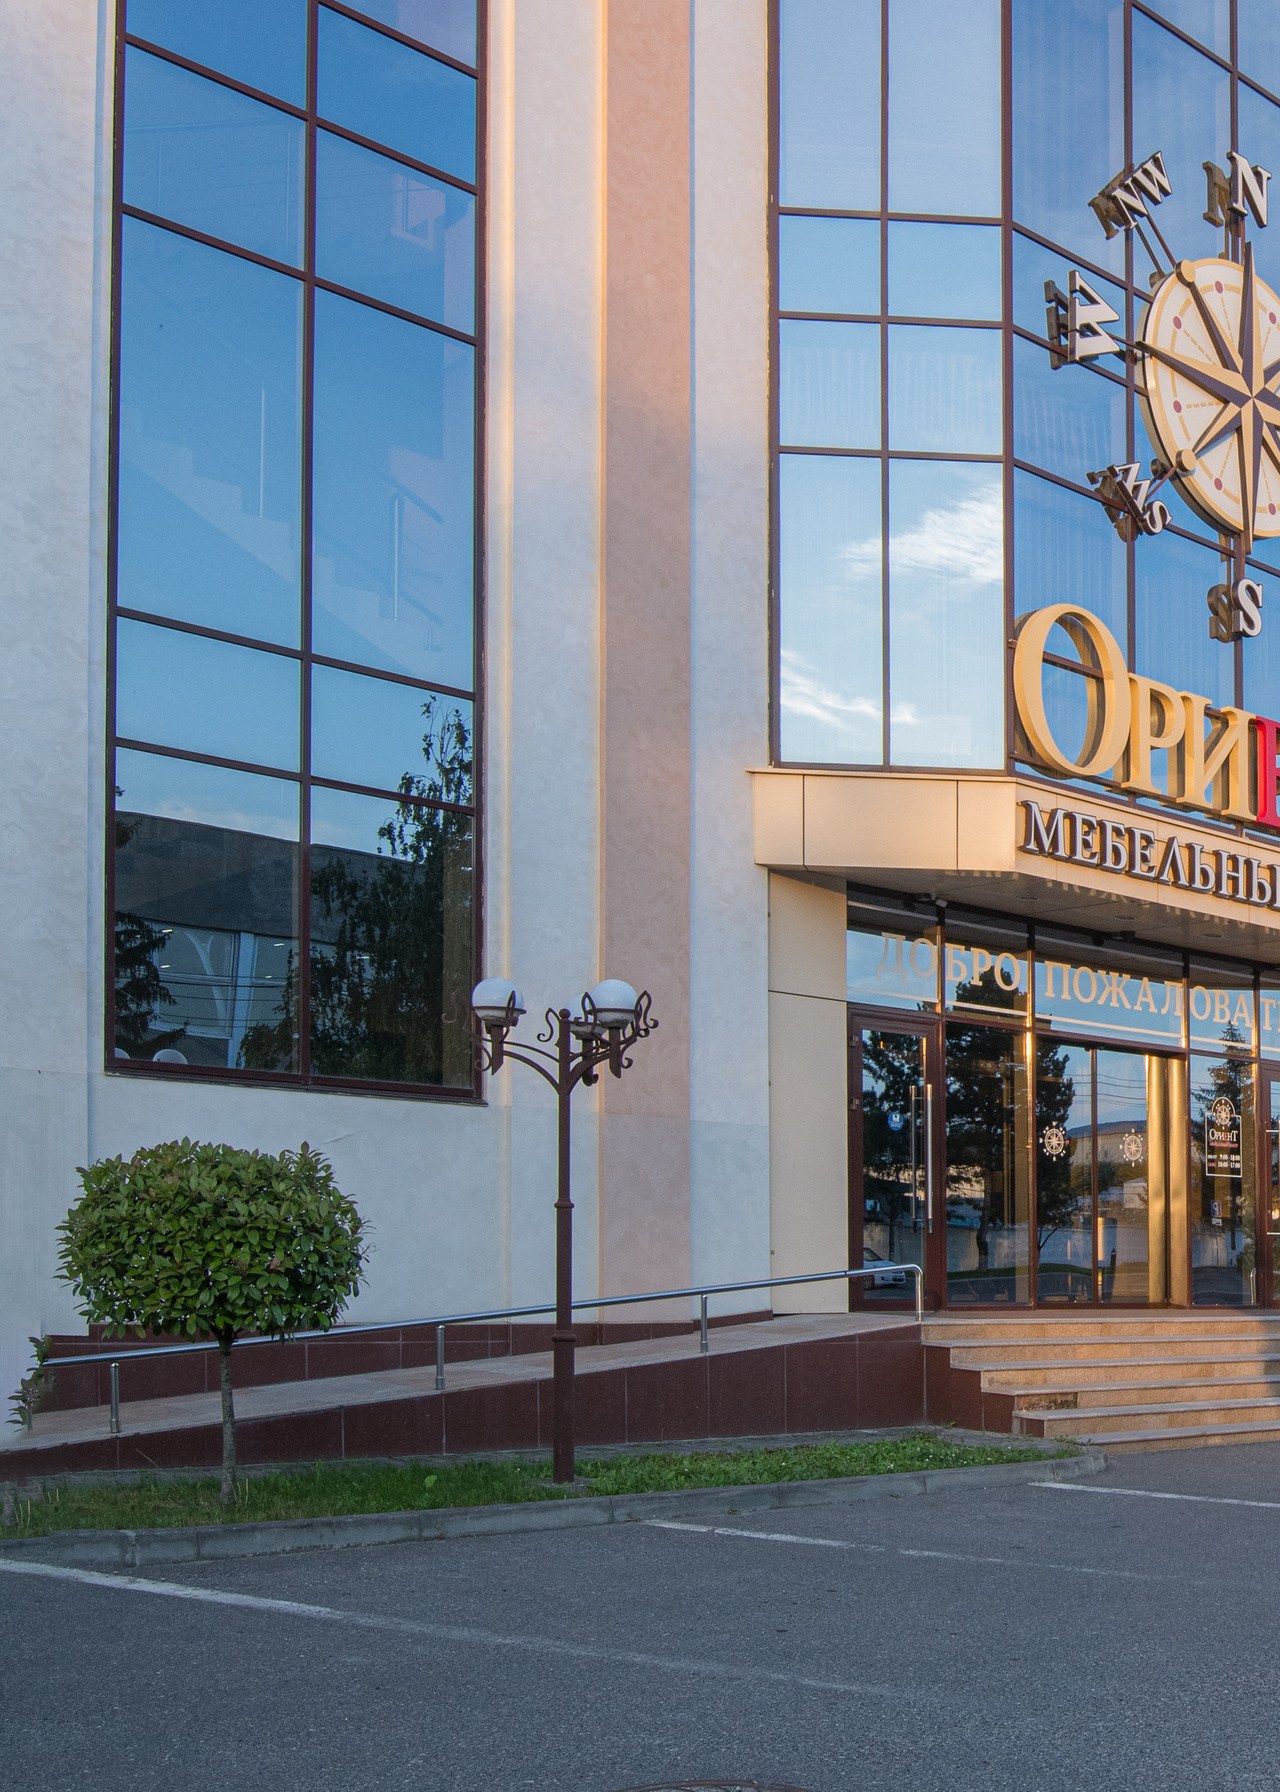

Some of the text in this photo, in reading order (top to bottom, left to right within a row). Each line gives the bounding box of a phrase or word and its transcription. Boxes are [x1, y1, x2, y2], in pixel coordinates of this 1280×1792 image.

[1108, 151, 1173, 231] NW
[1227, 151, 1272, 227] N
[1068, 270, 1120, 363] W
[1232, 579, 1263, 638] S
[876, 932, 1020, 991] ДОБРО
[1209, 1128, 1239, 1141] ОРИЕНТ
